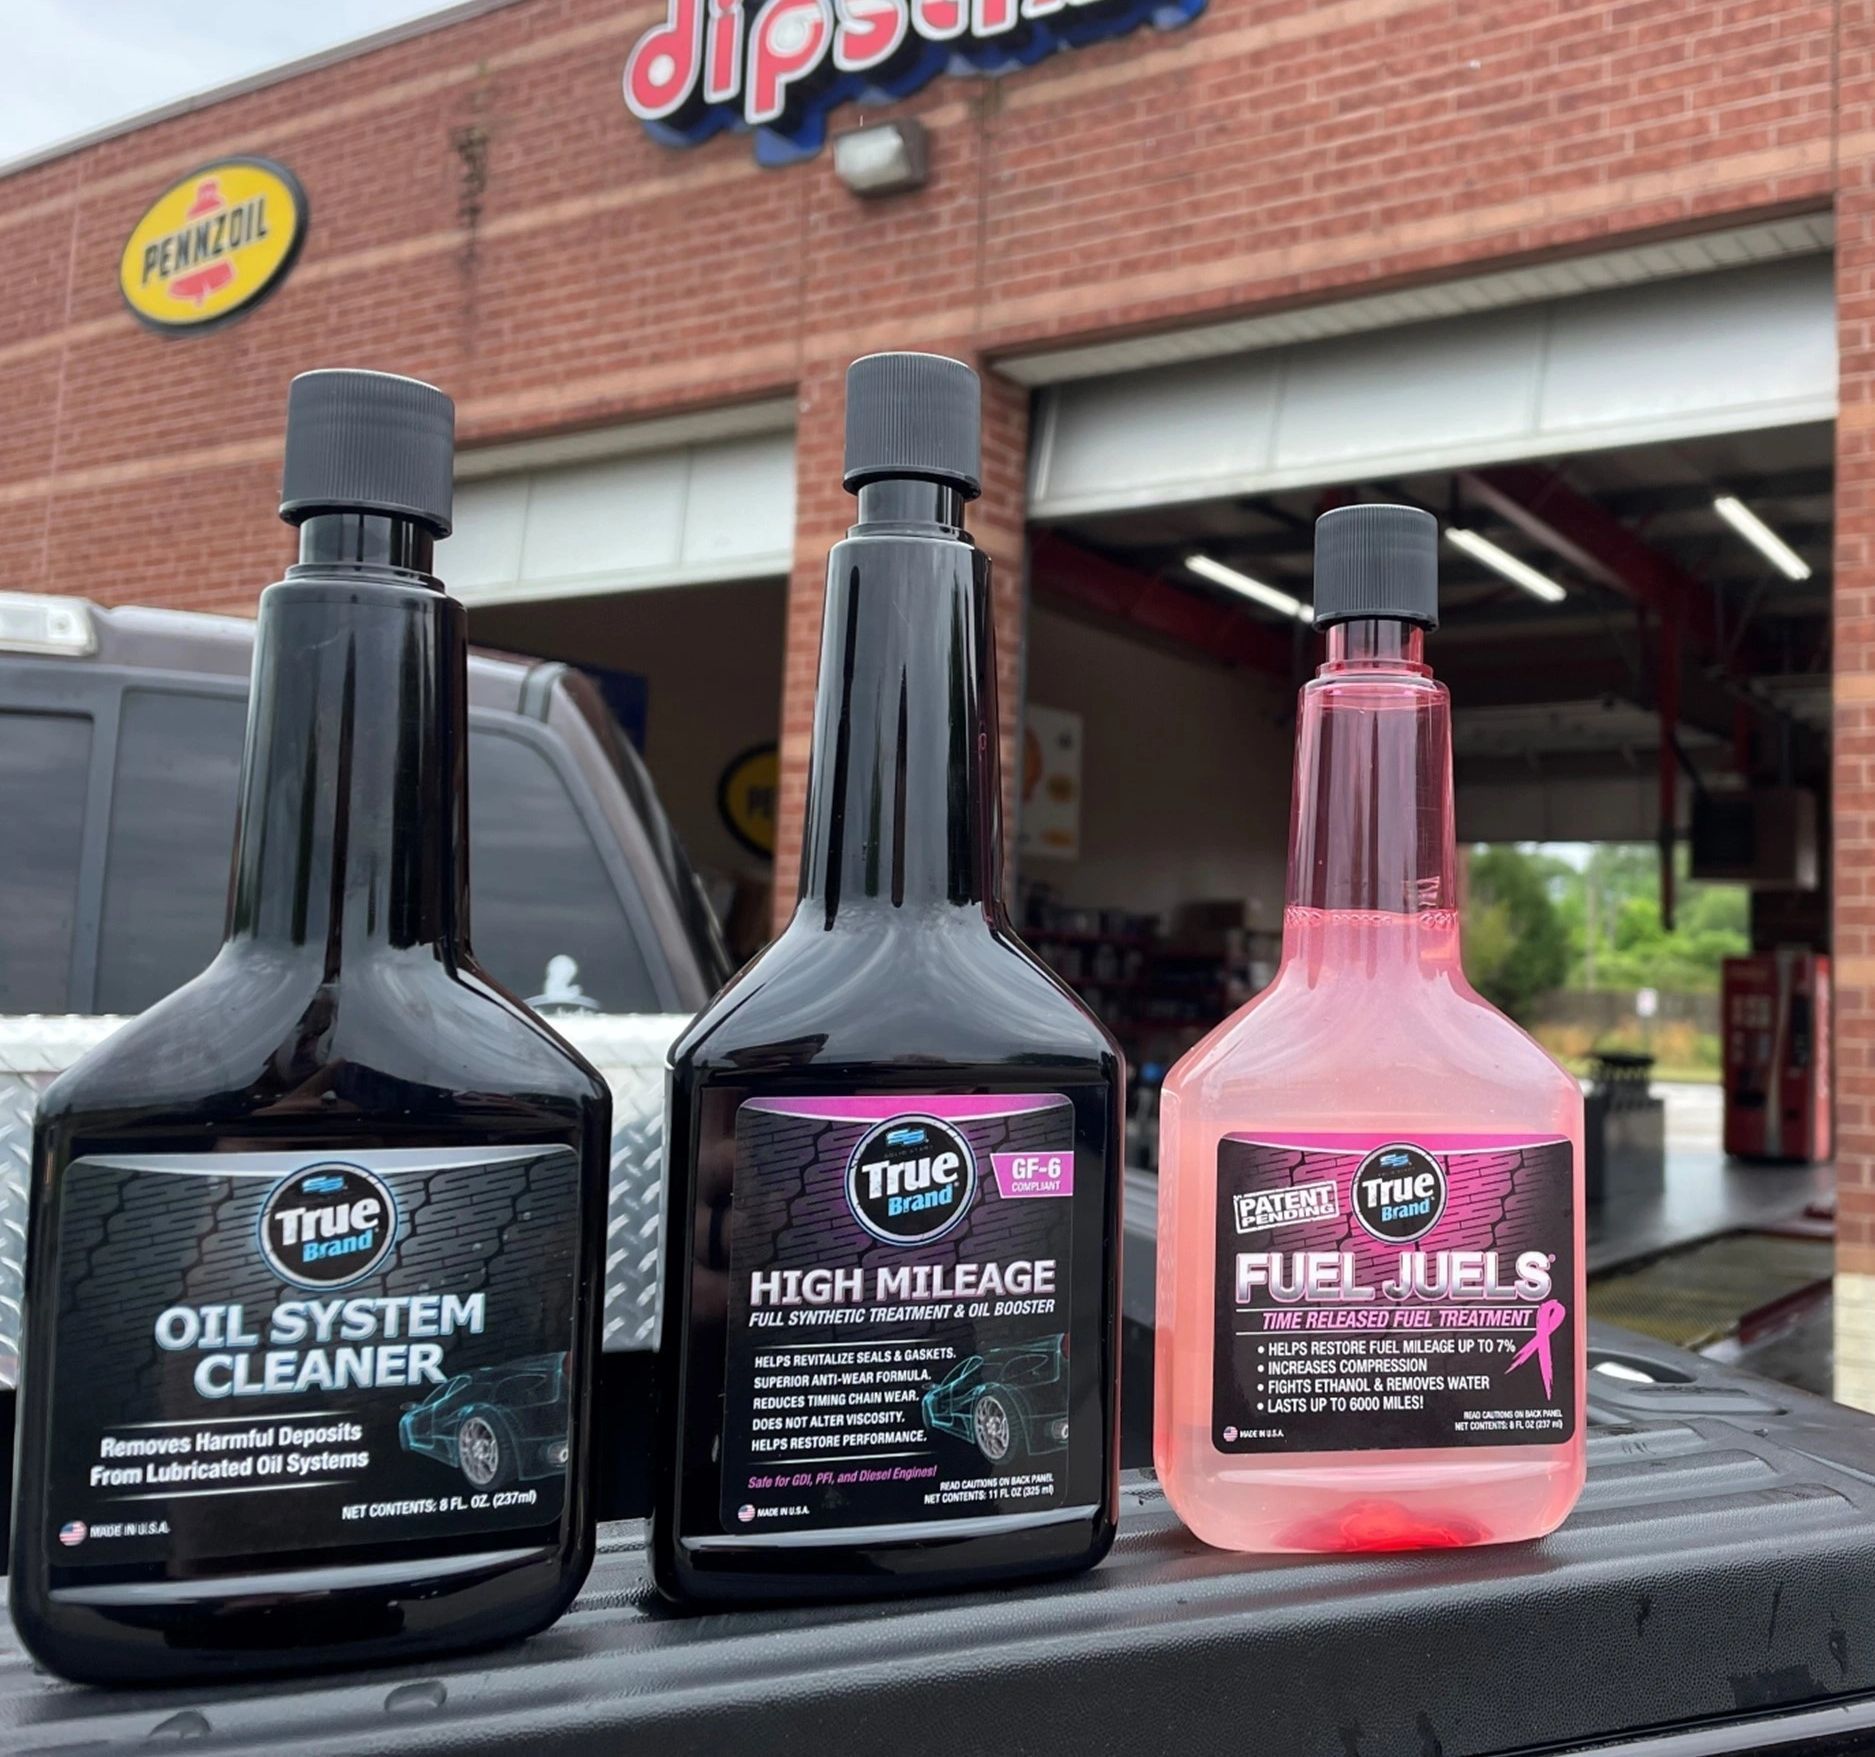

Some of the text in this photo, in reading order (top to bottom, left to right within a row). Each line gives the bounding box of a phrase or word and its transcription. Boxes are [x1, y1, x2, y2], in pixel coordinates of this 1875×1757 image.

[142, 197, 267, 285] PENNZOIL
[862, 1152, 959, 1199] True
[1012, 1158, 1060, 1179] GF-6
[1012, 1181, 1060, 1192] COMPLIANT
[1362, 1172, 1434, 1208] True
[888, 1184, 953, 1216] Brand
[1240, 1186, 1333, 1216] PATENT
[1382, 1199, 1430, 1222] Brand
[275, 1198, 380, 1245] True
[1241, 1205, 1334, 1227] PENDING
[303, 1228, 373, 1262] Brand
[750, 1260, 1056, 1306] HIGH MILEAGE
[1236, 1251, 1375, 1303] FUEL
[154, 1293, 485, 1350] OIL SYSTEM
[749, 1299, 1055, 1327] FULL SYNTHETIC TREATMENT & OIL BOOSTER
[1262, 1310, 1533, 1330] TIME RELEASED FUEL TREATMENT
[755, 1347, 956, 1368] HELPS REVITALIZE SEALS & GASKETS.
[1269, 1339, 1516, 1356] HELPS RESTORE FUEL MILEAGE UP TO 7%
[193, 1343, 449, 1399] CLEANER
[1268, 1358, 1427, 1374] INCREASES COMPRESSION
[754, 1369, 931, 1389] SUPERIOR ANTI-WEAR FORMULA.
[1268, 1376, 1490, 1393] FIGHTS ETHANOL & REMOVES WATER
[753, 1390, 919, 1410] REDUCES TIMING CHAIN WEAR.
[1268, 1396, 1423, 1412] LASTS UP TO 6000 MILES!
[752, 1411, 905, 1430] DOES NOT ALTER VISCOSITY.
[1464, 1411, 1480, 1419] READ
[1514, 1410, 1524, 1418] ON
[1240, 1430, 1257, 1438] MADE
[1455, 1422, 1468, 1430] NET
[1516, 1421, 1524, 1429] FL
[100, 1422, 363, 1458] Removes Harmful Deposits
[752, 1430, 927, 1451] HELPS RESTORE PERFORMANCE.
[90, 1450, 370, 1487] From Lubricated Oil Systems
[748, 1465, 937, 1489] Safe for GDI, PFI, and Diesel Engines!
[940, 1473, 1054, 1491] READ CAUTIONS ON BACK PANEL
[342, 1504, 367, 1520] NET
[369, 1499, 437, 1517] CONTENTS:
[439, 1498, 448, 1511] 8
[492, 1490, 537, 1509] (237ml)
[924, 1493, 940, 1504] NET
[942, 1490, 986, 1503] CONTENTS:
[989, 1489, 997, 1498] 11
[1000, 1488, 1009, 1498] FL
[1011, 1487, 1022, 1497] OZ
[1023, 1485, 1039, 1497] (325
[757, 1507, 778, 1517] MADE
[780, 1507, 788, 1516] IN
[90, 1524, 121, 1538] MADE
[124, 1523, 135, 1535] IN
